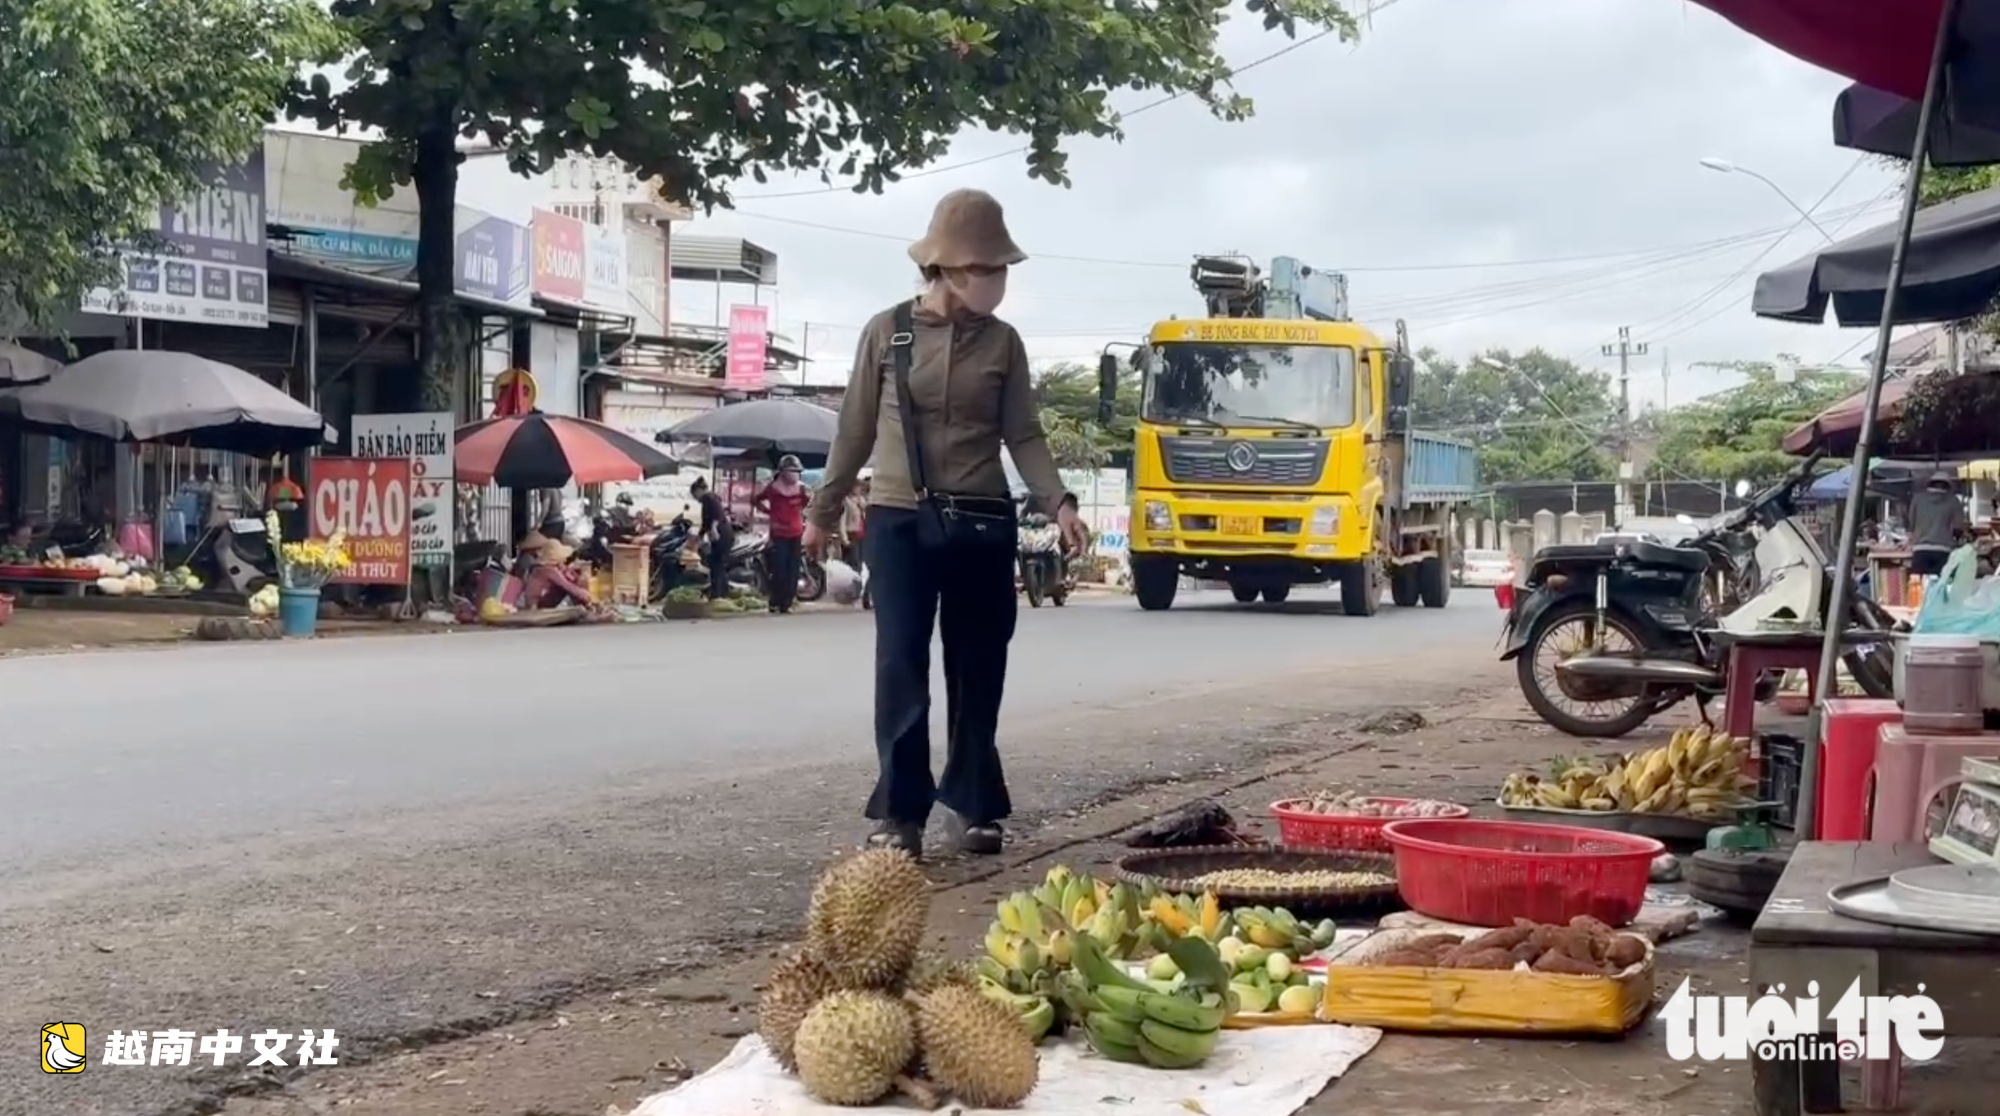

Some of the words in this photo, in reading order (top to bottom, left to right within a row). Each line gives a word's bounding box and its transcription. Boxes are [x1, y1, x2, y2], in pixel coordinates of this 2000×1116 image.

[358, 429, 384, 457] BÁN
[387, 424, 412, 455] BẢO
[415, 419, 446, 455] HIỂM
[315, 461, 405, 537] CHÁO
